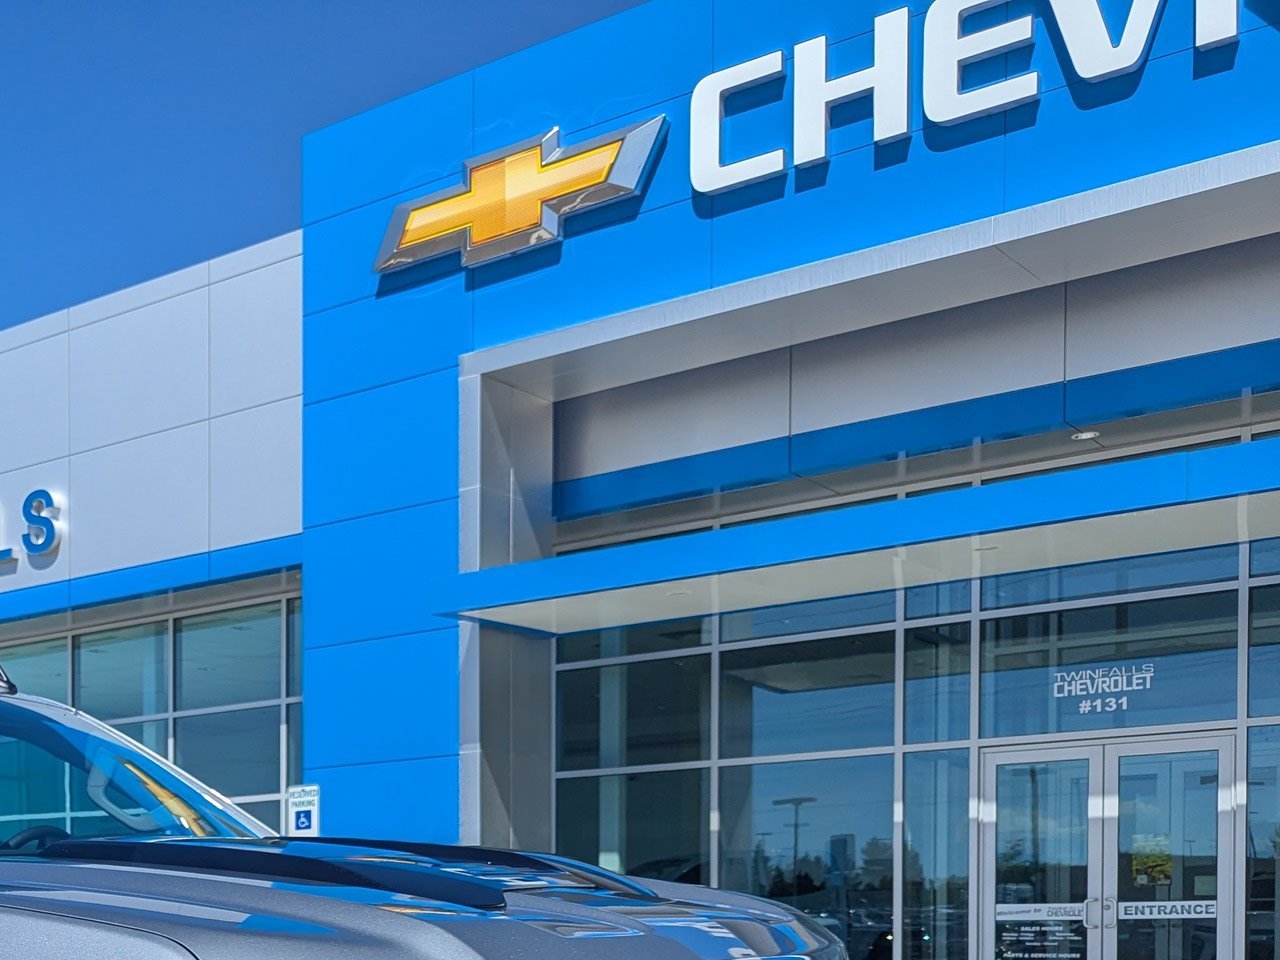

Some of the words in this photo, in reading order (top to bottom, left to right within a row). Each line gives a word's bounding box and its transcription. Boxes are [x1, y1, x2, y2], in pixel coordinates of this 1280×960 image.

[689, 0, 1238, 195] CHEV
[1053, 673, 1154, 697] CHEVROLET
[1078, 696, 1128, 714] #131
[1123, 904, 1216, 916] ENTRANCE
